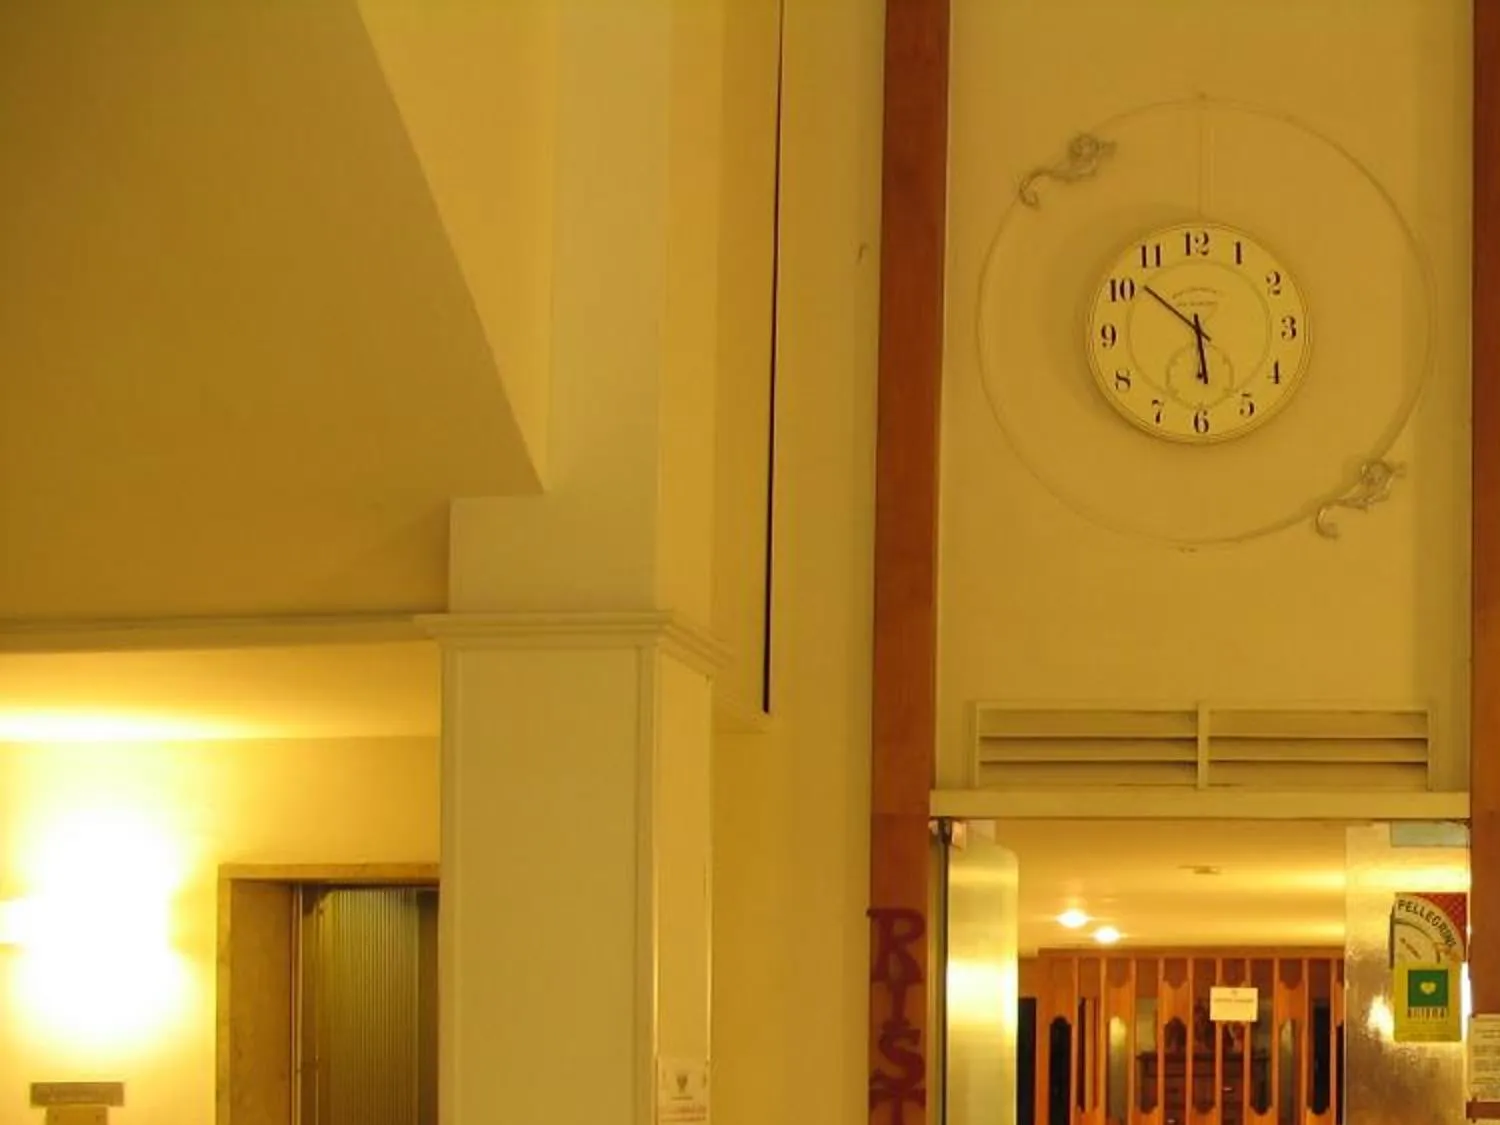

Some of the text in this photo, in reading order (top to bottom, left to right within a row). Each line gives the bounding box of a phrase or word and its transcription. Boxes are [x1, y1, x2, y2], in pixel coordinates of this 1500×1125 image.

[1185, 231, 1210, 256] 12
[1235, 241, 1242, 264] 1
[1141, 244, 1161, 268] 11
[1110, 278, 1135, 302] 10
[1266, 271, 1281, 295] 2
[1101, 324, 1116, 348] 9
[1281, 315, 1296, 340] 3
[1115, 369, 1131, 392] 8
[1267, 360, 1281, 384] 4
[1152, 399, 1164, 423] 7
[1239, 393, 1254, 417] 5
[1193, 410, 1209, 434] 6
